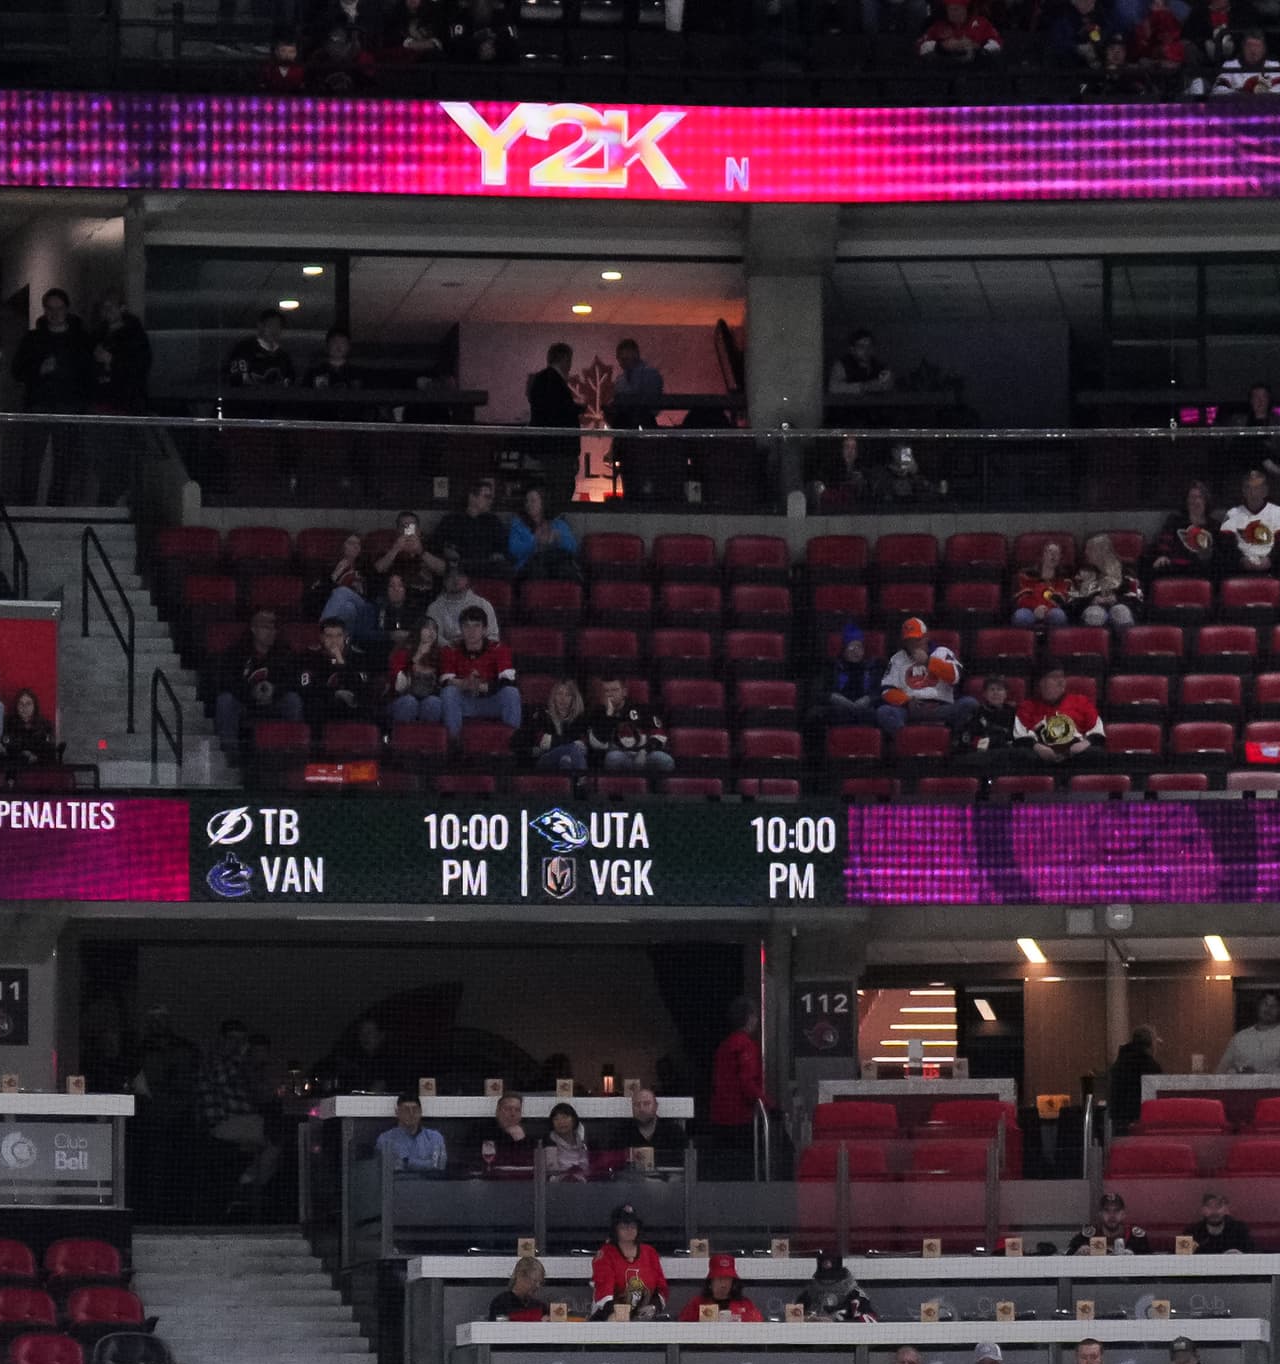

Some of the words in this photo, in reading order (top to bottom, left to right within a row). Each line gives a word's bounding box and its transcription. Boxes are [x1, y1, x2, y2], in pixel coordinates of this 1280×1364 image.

[439, 101, 688, 189] Y2K
[259, 807, 300, 845] TB
[423, 813, 509, 851] 10:00
[590, 811, 650, 849] UTA
[750, 816, 836, 853] 10:00
[260, 856, 324, 893] VAN
[442, 860, 488, 897] PM
[590, 859, 654, 896] VGK
[769, 863, 815, 899] PM
[800, 993, 849, 1014] 112
[55, 1150, 89, 1170] Bell
